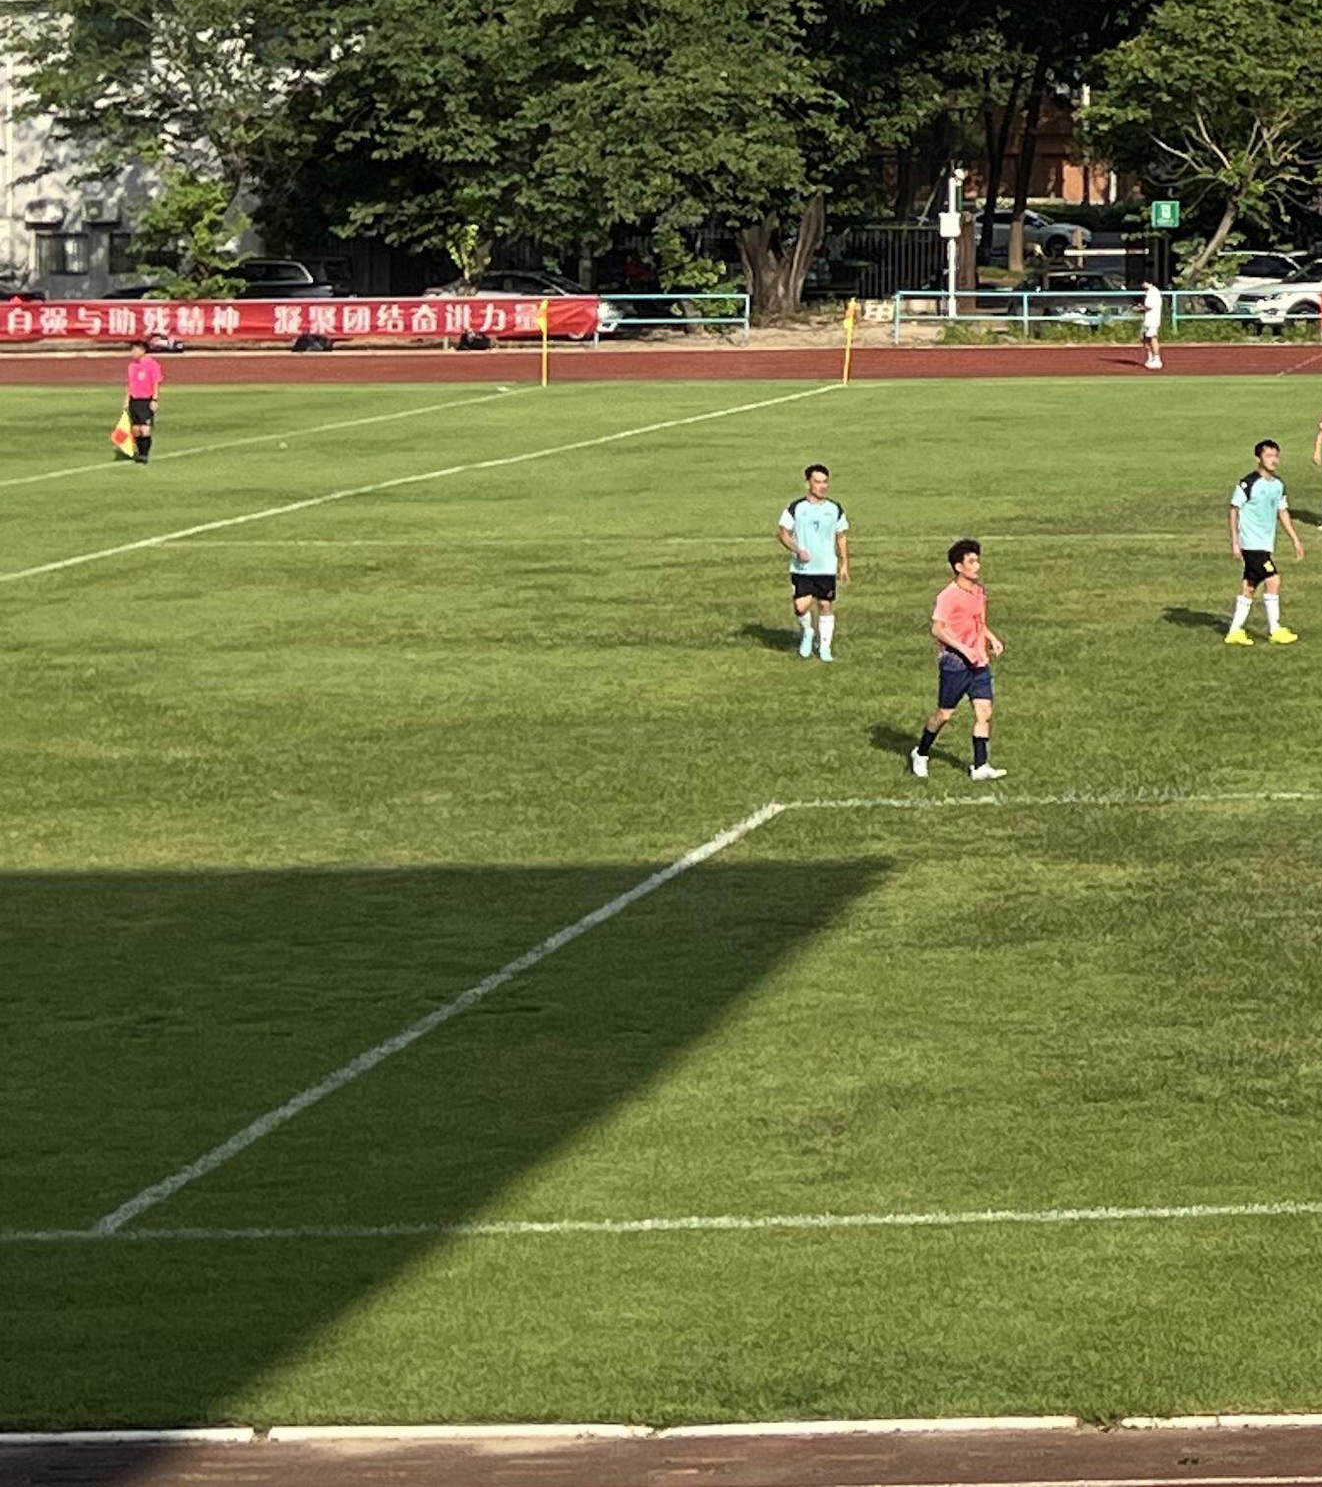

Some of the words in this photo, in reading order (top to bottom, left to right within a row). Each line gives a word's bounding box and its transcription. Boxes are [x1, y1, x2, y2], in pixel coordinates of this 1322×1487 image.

[6, 305, 241, 335] 自强与助残精神
[273, 304, 539, 334] 凝聚团结奋进力量
